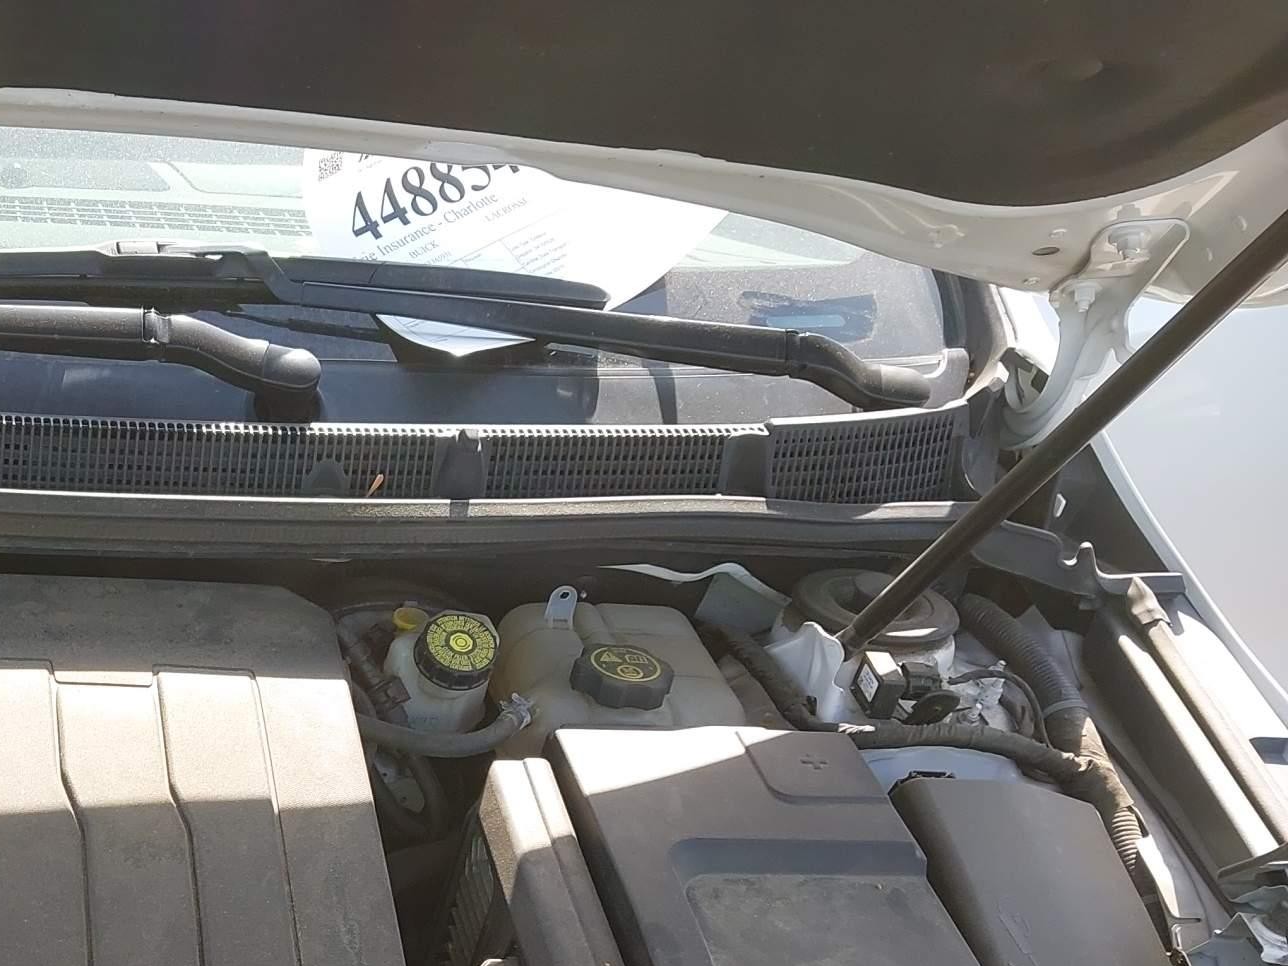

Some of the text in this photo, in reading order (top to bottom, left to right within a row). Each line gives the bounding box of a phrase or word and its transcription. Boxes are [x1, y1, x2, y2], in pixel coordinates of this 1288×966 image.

[352, 162, 521, 240] 44885
[379, 221, 435, 257] Insurance
[443, 192, 499, 224] Charlotte
